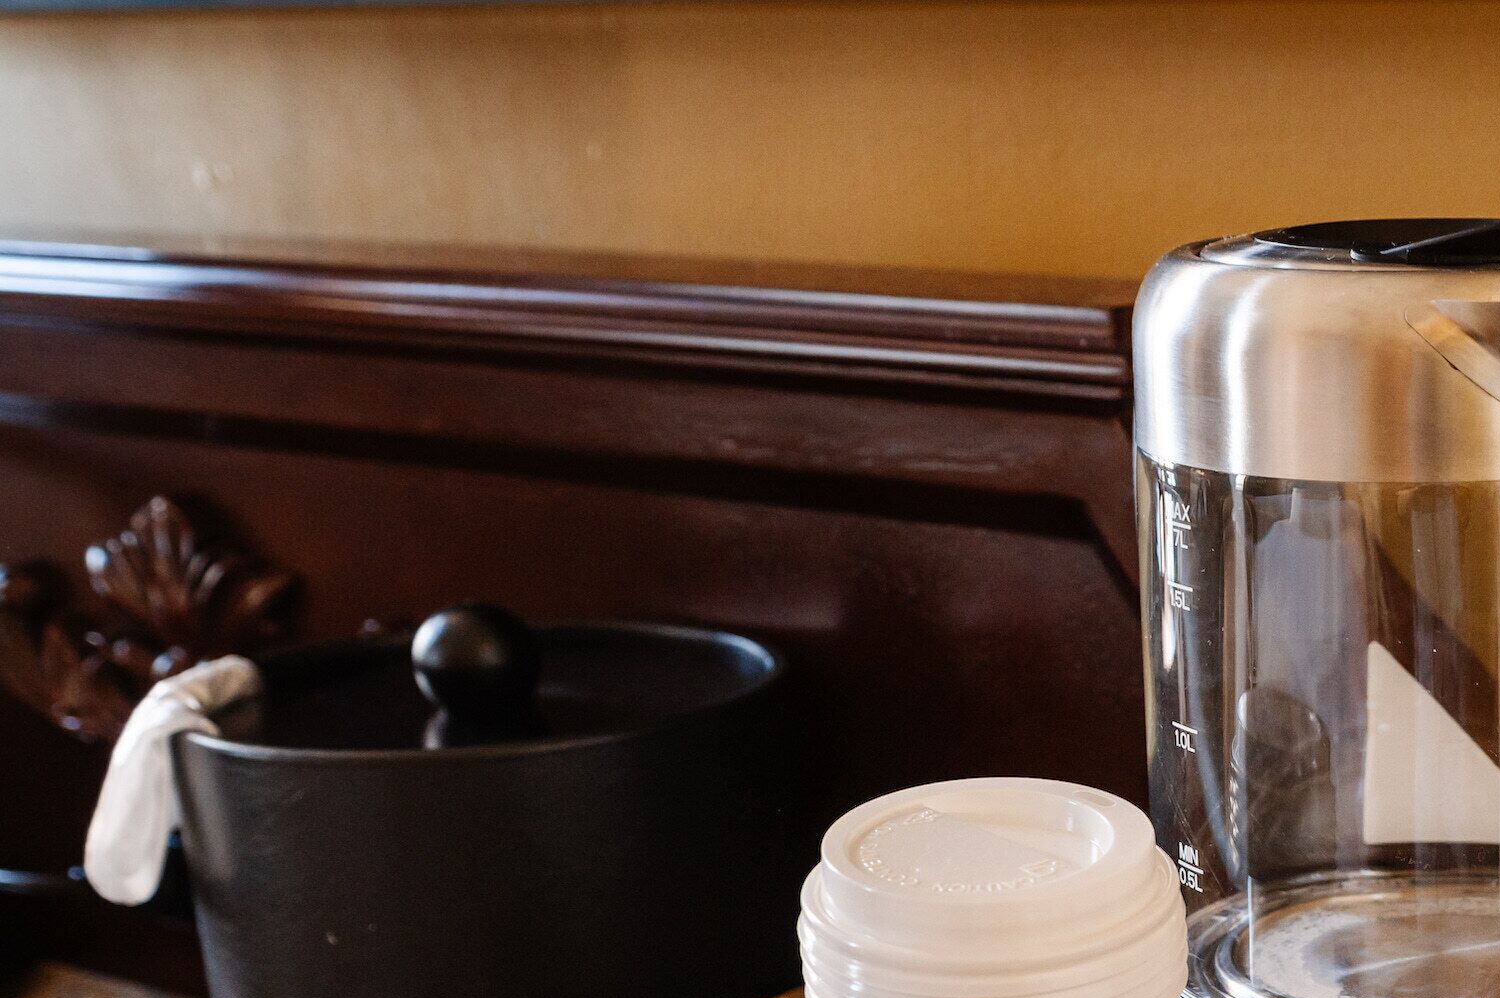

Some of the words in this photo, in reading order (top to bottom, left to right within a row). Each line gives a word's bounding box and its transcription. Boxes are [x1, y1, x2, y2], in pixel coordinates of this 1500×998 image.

[1168, 500, 1191, 523] AX
[1178, 841, 1199, 867] MIN
[1179, 867, 1204, 893] 0.5L
